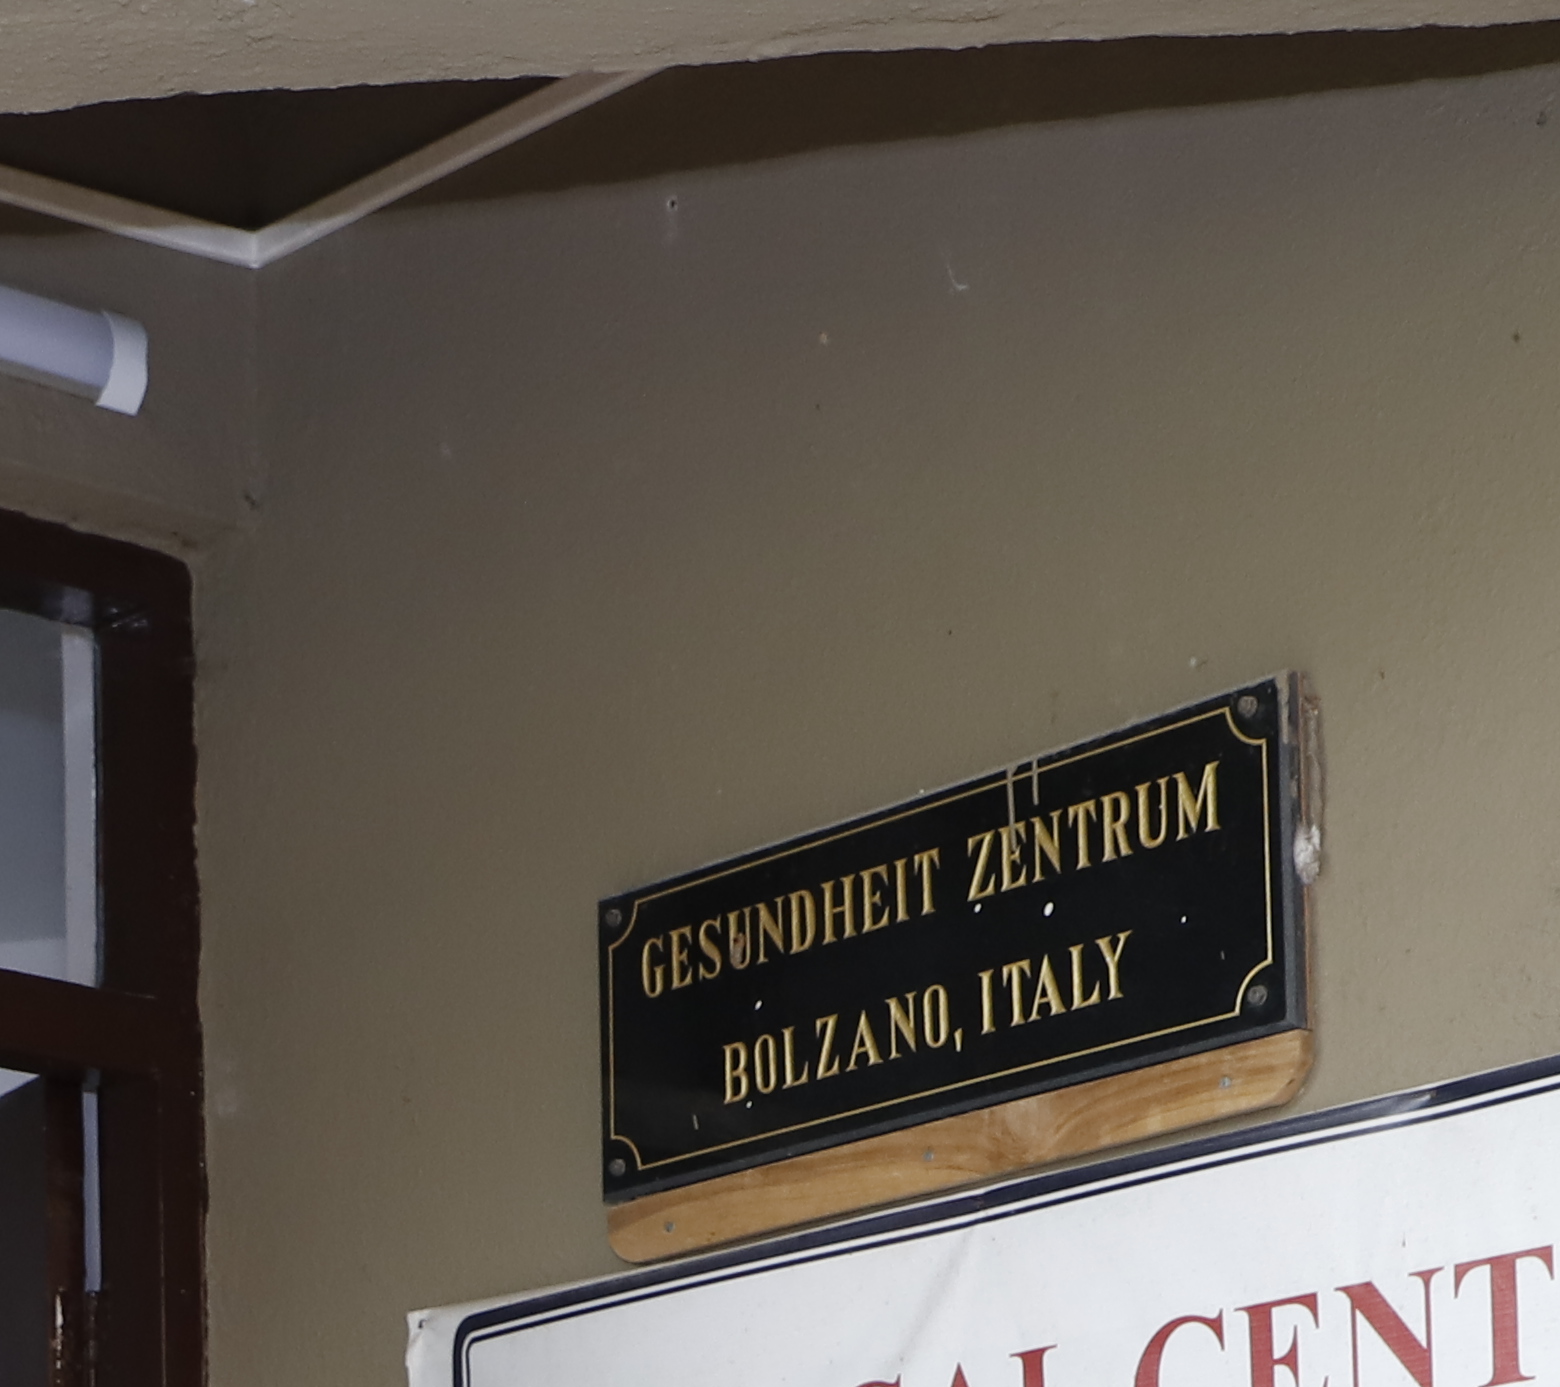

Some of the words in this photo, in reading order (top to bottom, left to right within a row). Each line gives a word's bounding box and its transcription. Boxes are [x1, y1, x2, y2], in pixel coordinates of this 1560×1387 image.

[640, 847, 941, 999] GESUNDHEIT
[966, 761, 1221, 901] ZENTRUM
[722, 984, 965, 1105] BOLZANO,
[979, 929, 1133, 1034] ITALY
